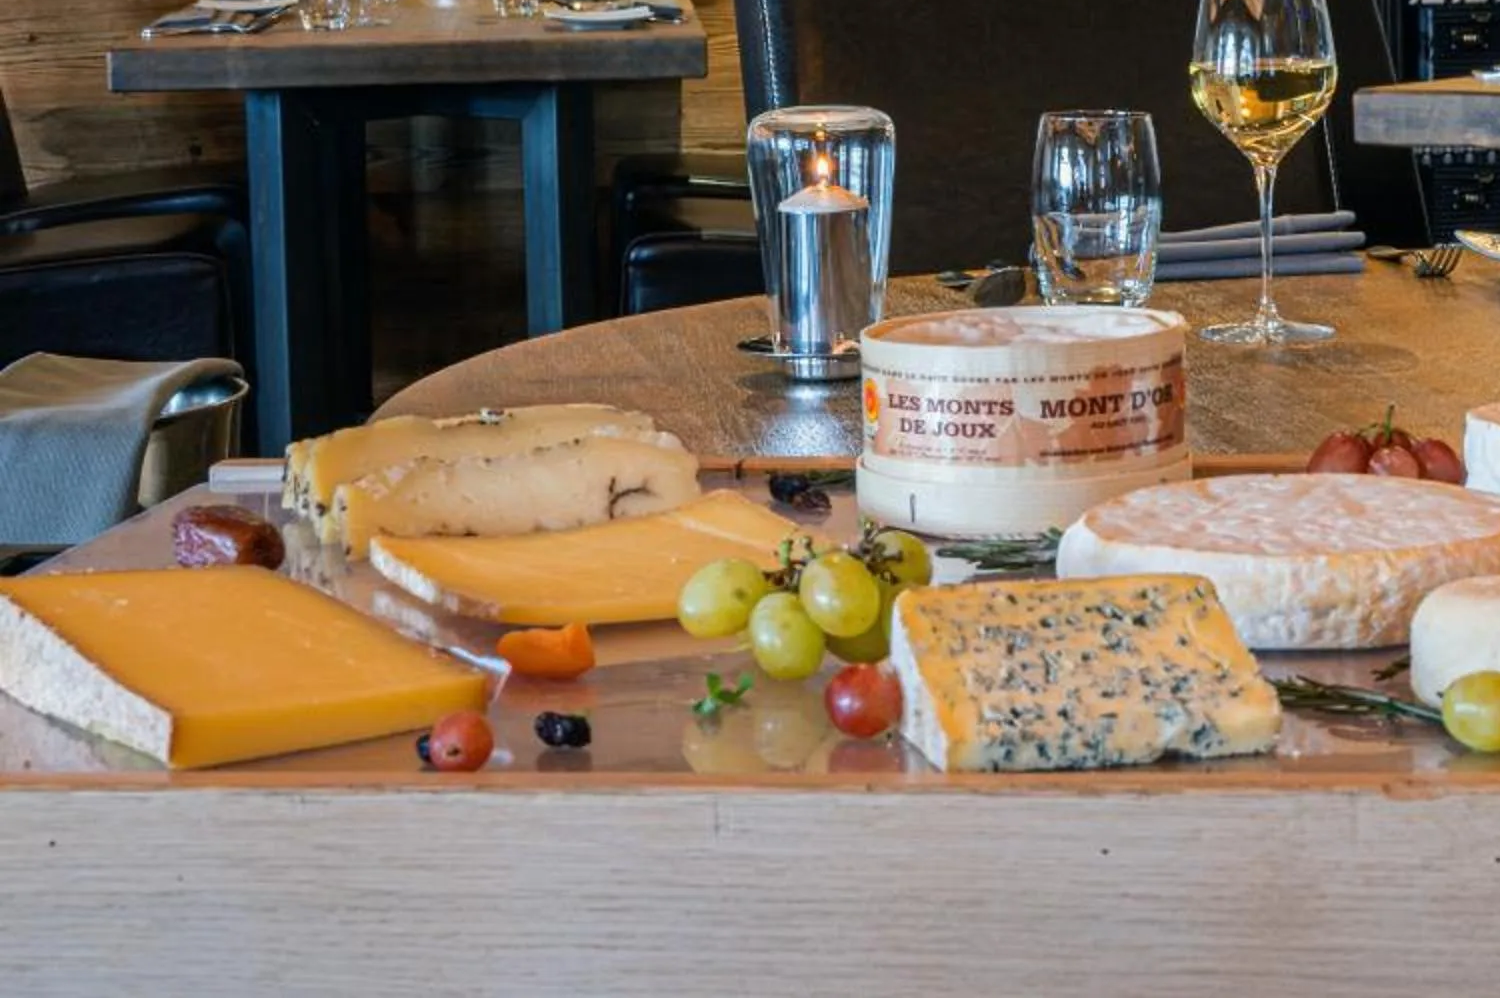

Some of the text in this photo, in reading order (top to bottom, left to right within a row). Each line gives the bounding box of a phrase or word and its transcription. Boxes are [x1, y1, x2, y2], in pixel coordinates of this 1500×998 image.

[887, 393, 1016, 417] LES MONTS
[1039, 394, 1125, 420] MONT
[899, 417, 997, 439] DE JOUX
